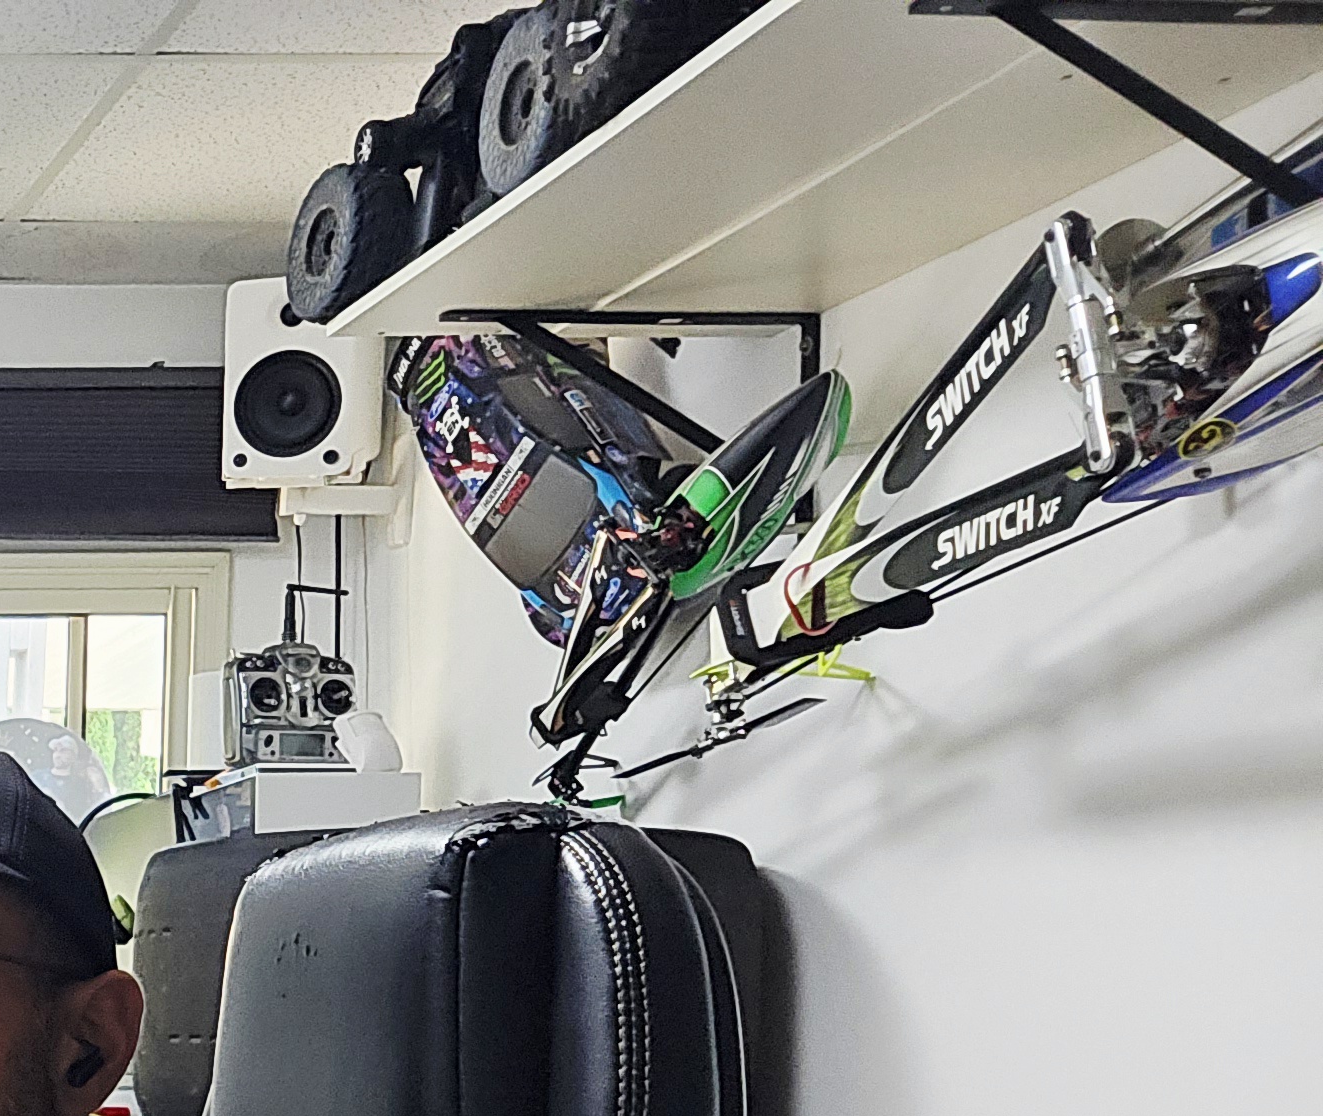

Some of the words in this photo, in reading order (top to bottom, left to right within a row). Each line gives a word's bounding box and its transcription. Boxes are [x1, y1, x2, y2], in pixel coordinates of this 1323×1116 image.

[924, 317, 1011, 451] SWITCH
[1012, 302, 1031, 346] XF
[482, 466, 513, 509] HOONIGAN
[930, 494, 1036, 570] SWITCH
[1037, 496, 1062, 528] XF
